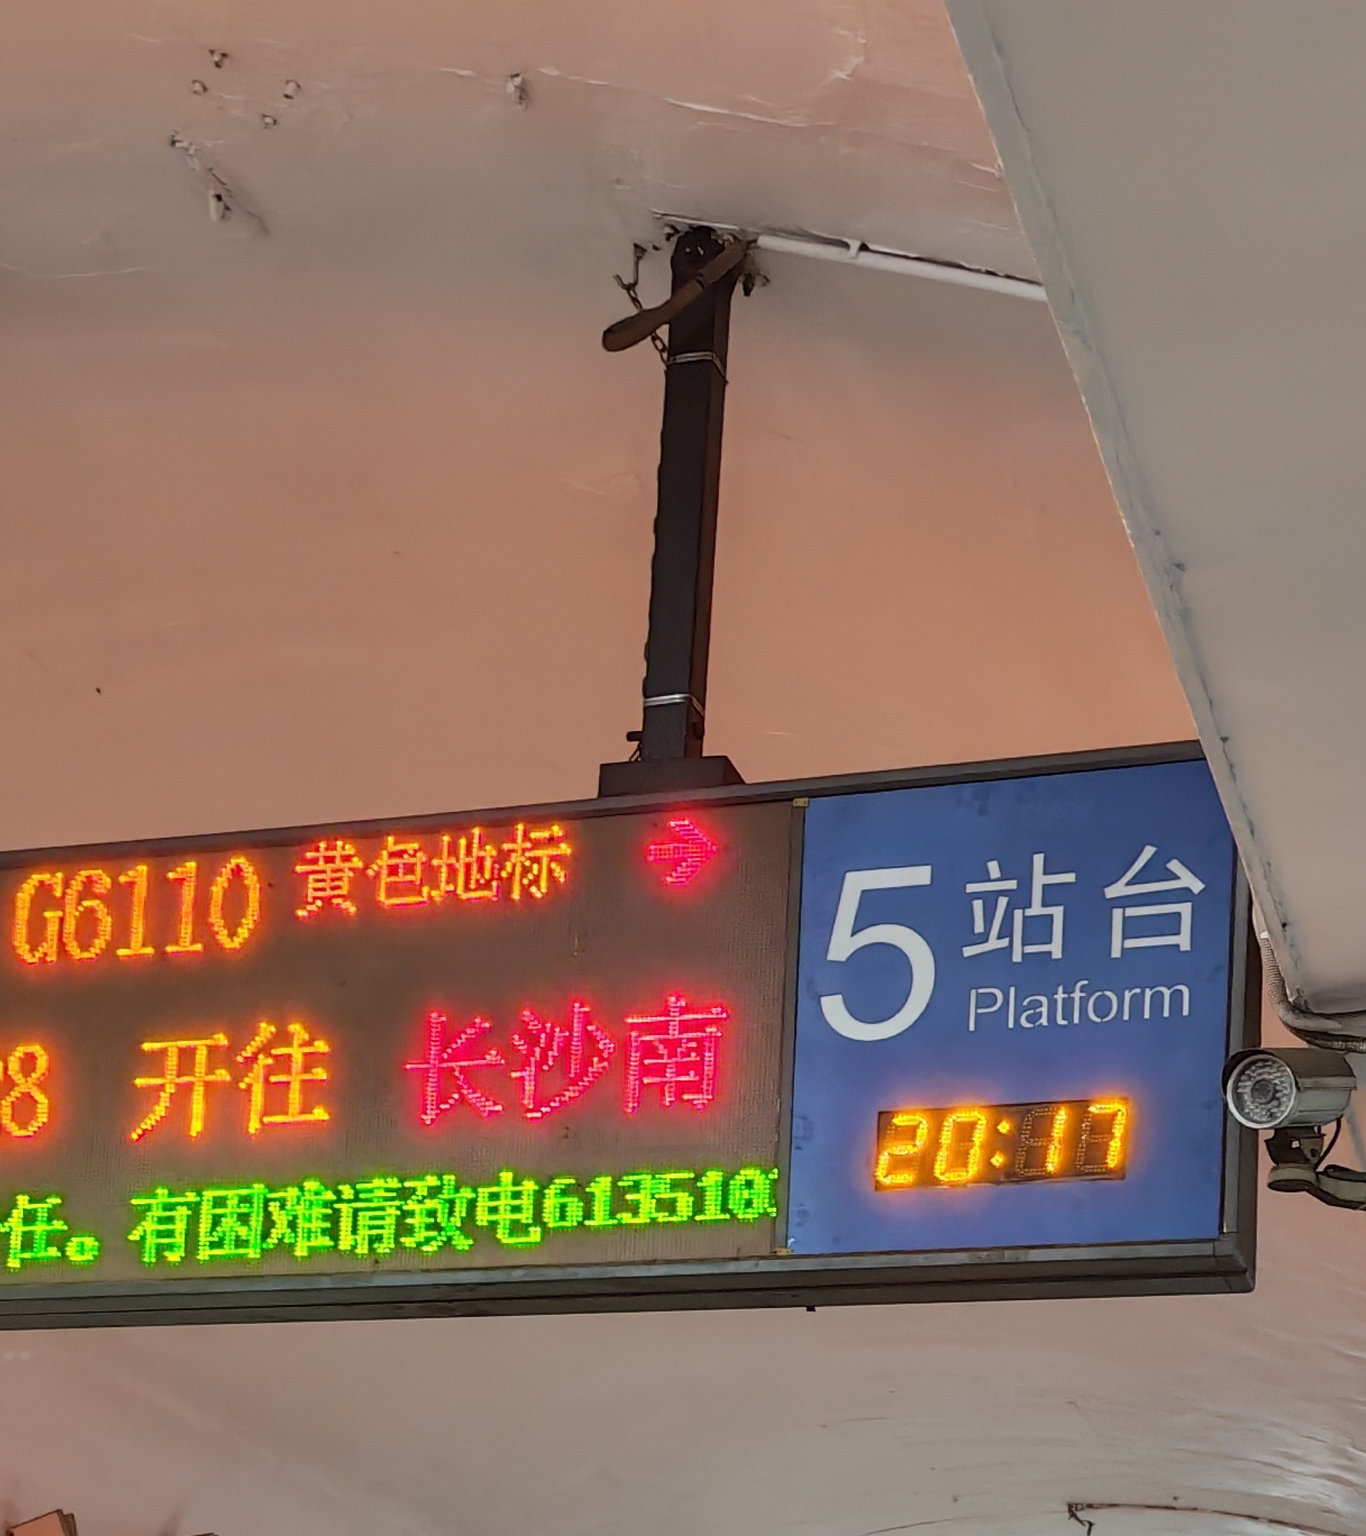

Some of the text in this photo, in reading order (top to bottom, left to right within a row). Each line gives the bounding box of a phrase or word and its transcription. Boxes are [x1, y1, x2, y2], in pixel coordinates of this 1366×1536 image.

[11, 823, 572, 965] G6110 黄色地标
[819, 844, 1206, 1041] 5 站台
[967, 980, 1191, 1032] Platform
[129, 1021, 330, 1142] 开往
[404, 993, 730, 1127] 长沙南
[873, 1100, 1128, 1187] 20:17
[129, 1168, 779, 1266] 有困难请致电613510
